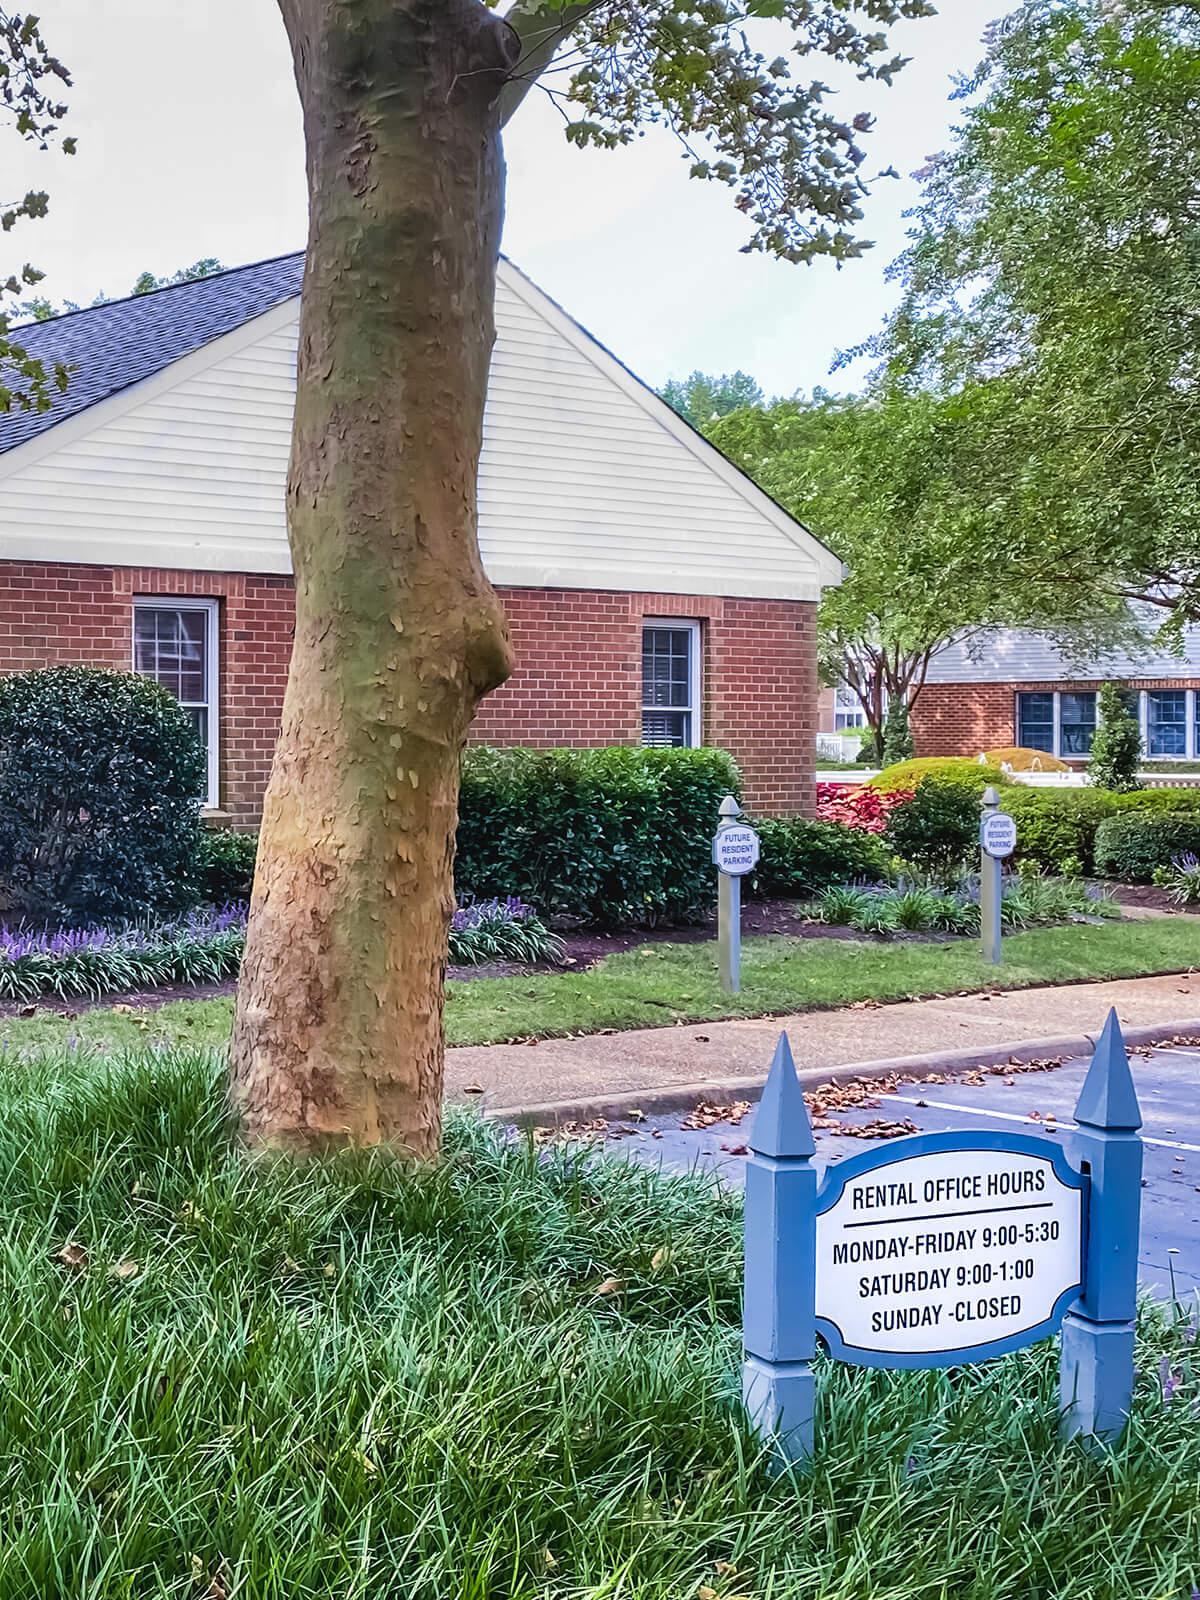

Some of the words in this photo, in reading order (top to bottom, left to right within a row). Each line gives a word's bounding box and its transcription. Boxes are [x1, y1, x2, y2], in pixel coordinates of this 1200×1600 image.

[722, 845, 753, 854] RESIDENT
[725, 833, 751, 842] FUTURE
[724, 856, 752, 865] PARKING
[852, 1181, 918, 1210] RENTAL
[923, 1175, 982, 1203] OFFICE
[987, 1168, 1045, 1196] HOURS
[832, 1229, 977, 1265] MONDAY-FRIDAY
[982, 1220, 1060, 1248] 9:00-5:30
[858, 1267, 951, 1298] SATURDAY
[956, 1258, 1034, 1287] 9:00-1:00
[871, 1304, 943, 1333] SUNDAY
